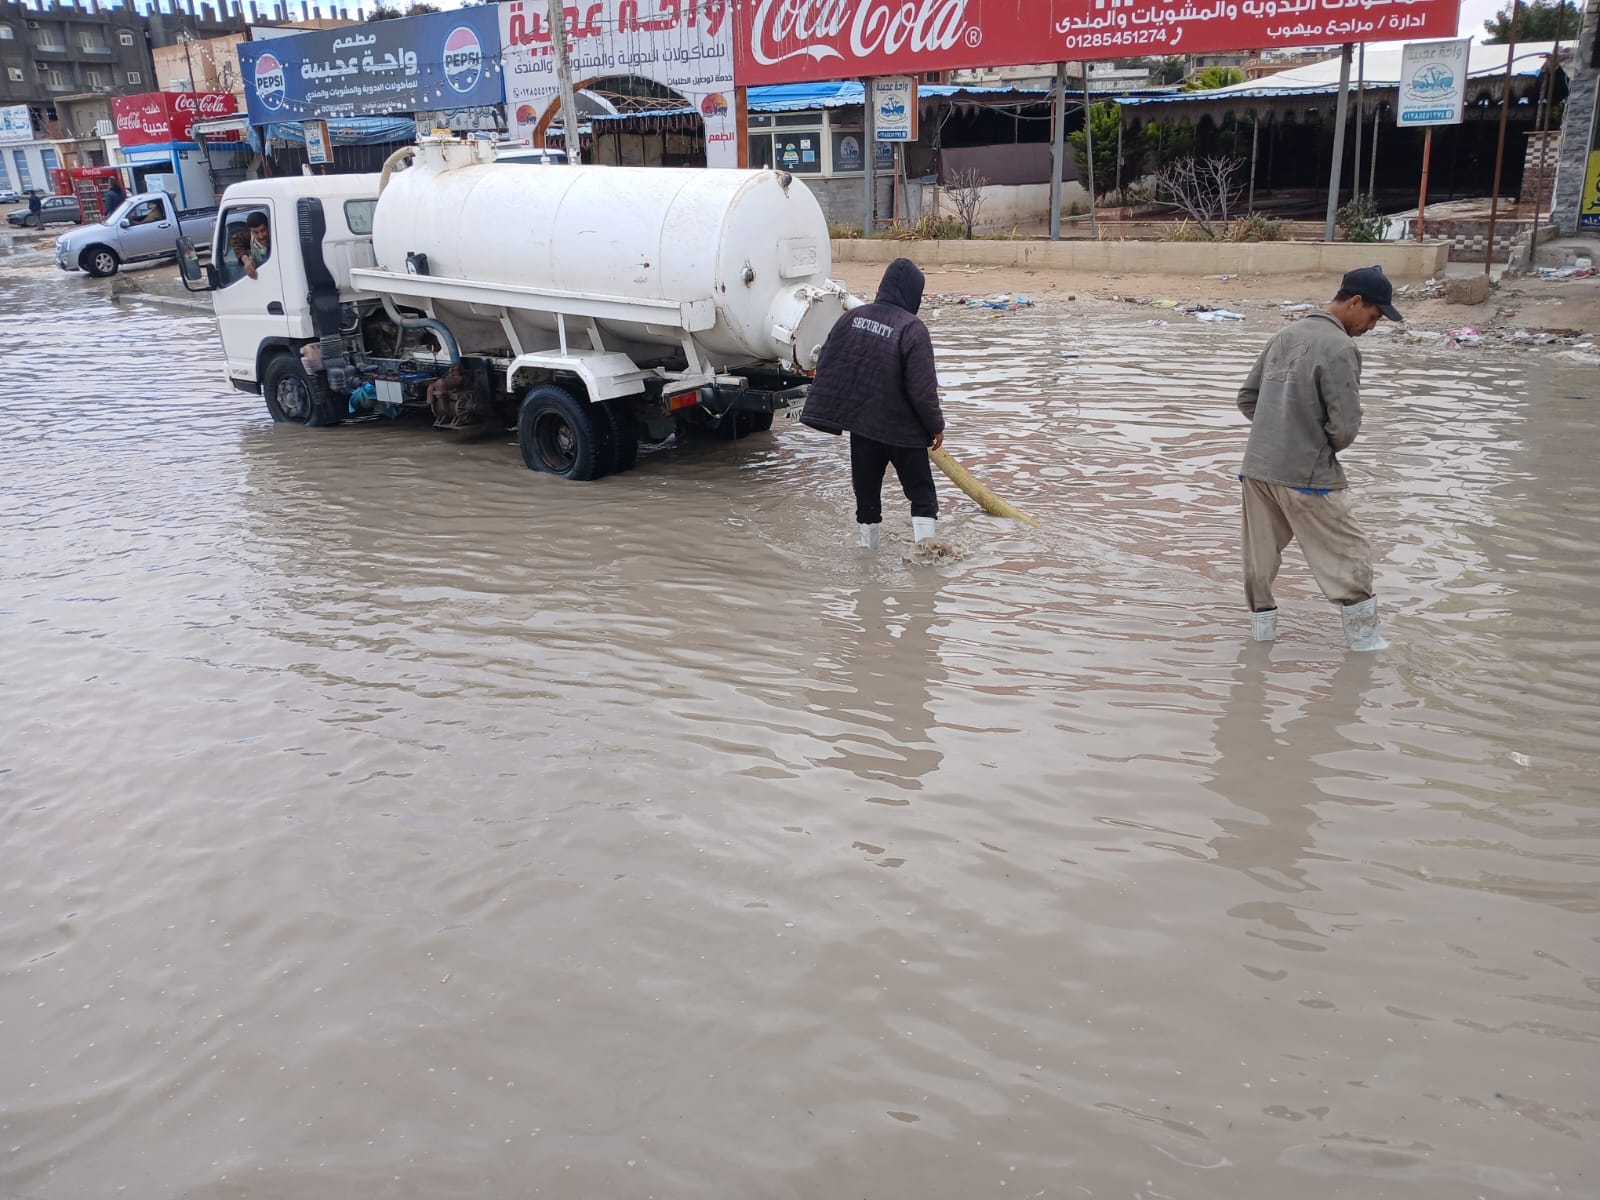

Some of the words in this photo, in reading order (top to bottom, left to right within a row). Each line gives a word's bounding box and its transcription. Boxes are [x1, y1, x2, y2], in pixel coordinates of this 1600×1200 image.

[1055, 9, 1127, 34] والمندى
[1131, 0, 1238, 26] والمشويات
[1325, 18, 1374, 36] مراجع
[332, 33, 377, 54] مطعم
[1065, 28, 1167, 49] 01285451274
[300, 56, 359, 84] عجيبة
[445, 51, 479, 68] PEPSI
[514, 59, 553, 74] والمندى
[256, 74, 283, 89] PEPSI
[852, 317, 894, 338] SECURITY
